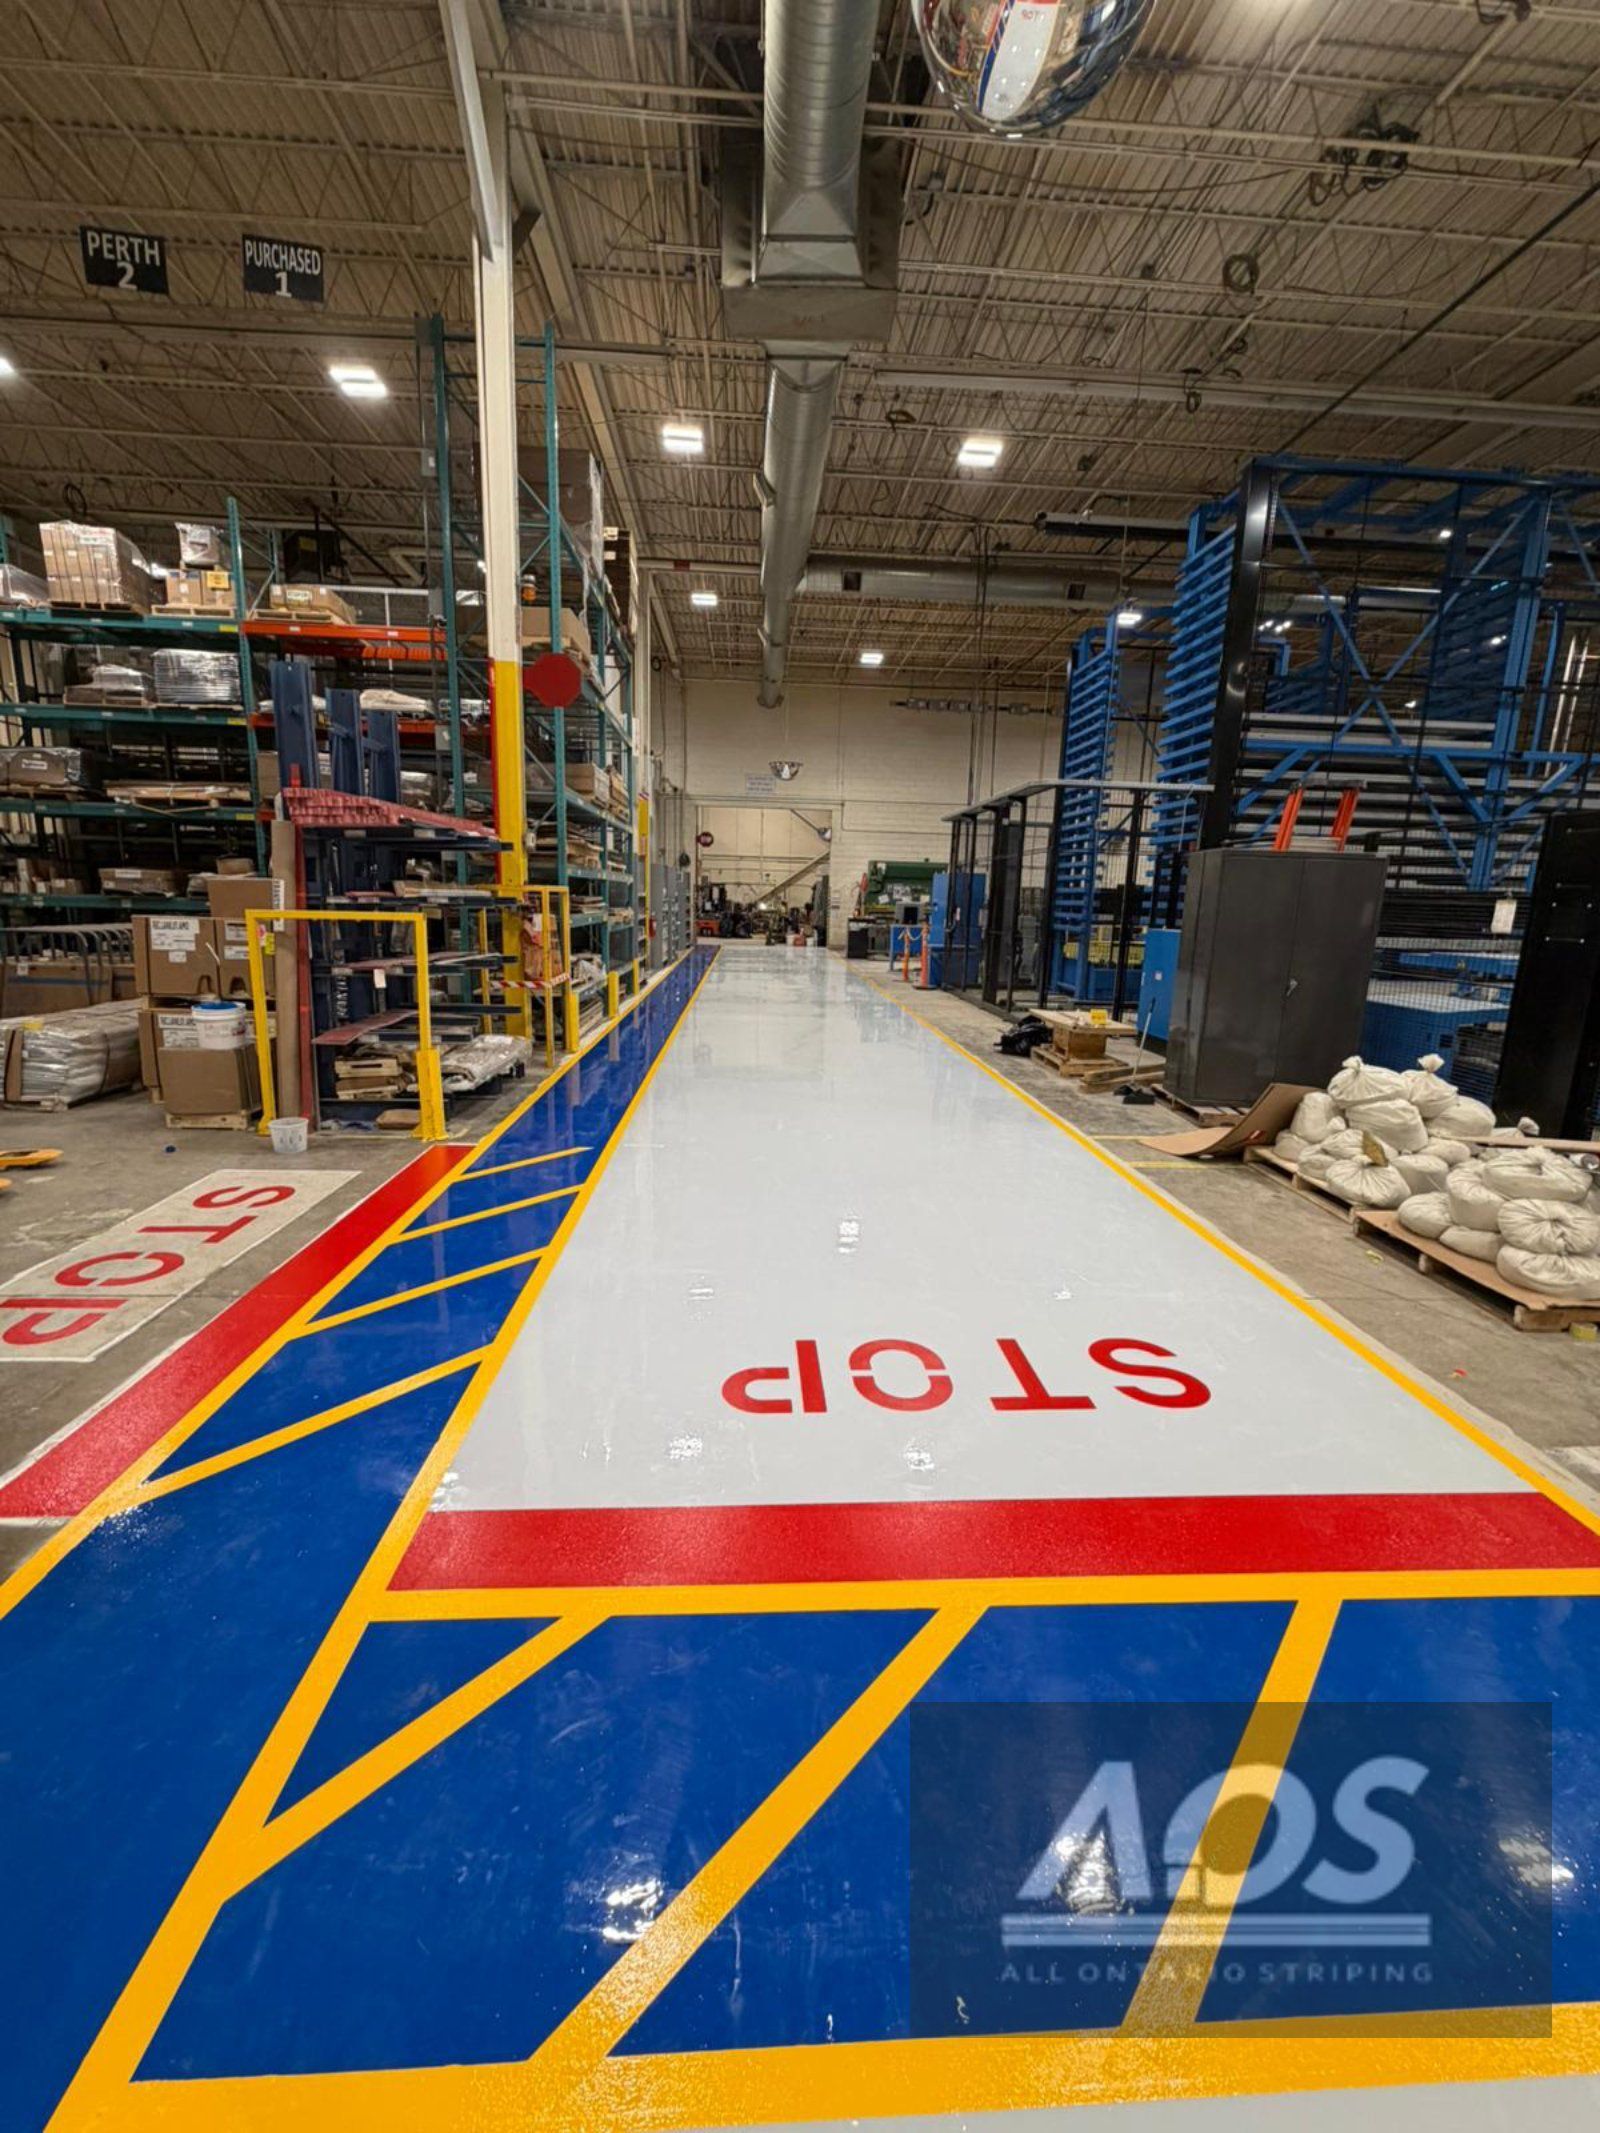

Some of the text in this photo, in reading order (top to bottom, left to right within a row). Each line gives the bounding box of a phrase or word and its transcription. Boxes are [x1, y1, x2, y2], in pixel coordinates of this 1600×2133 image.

[87, 231, 160, 266] PERTH
[245, 240, 321, 276] PURCHASED
[115, 261, 138, 290] 2
[274, 271, 292, 297] 1
[0, 1186, 296, 1345] STOP
[721, 1337, 1212, 1414] STOP
